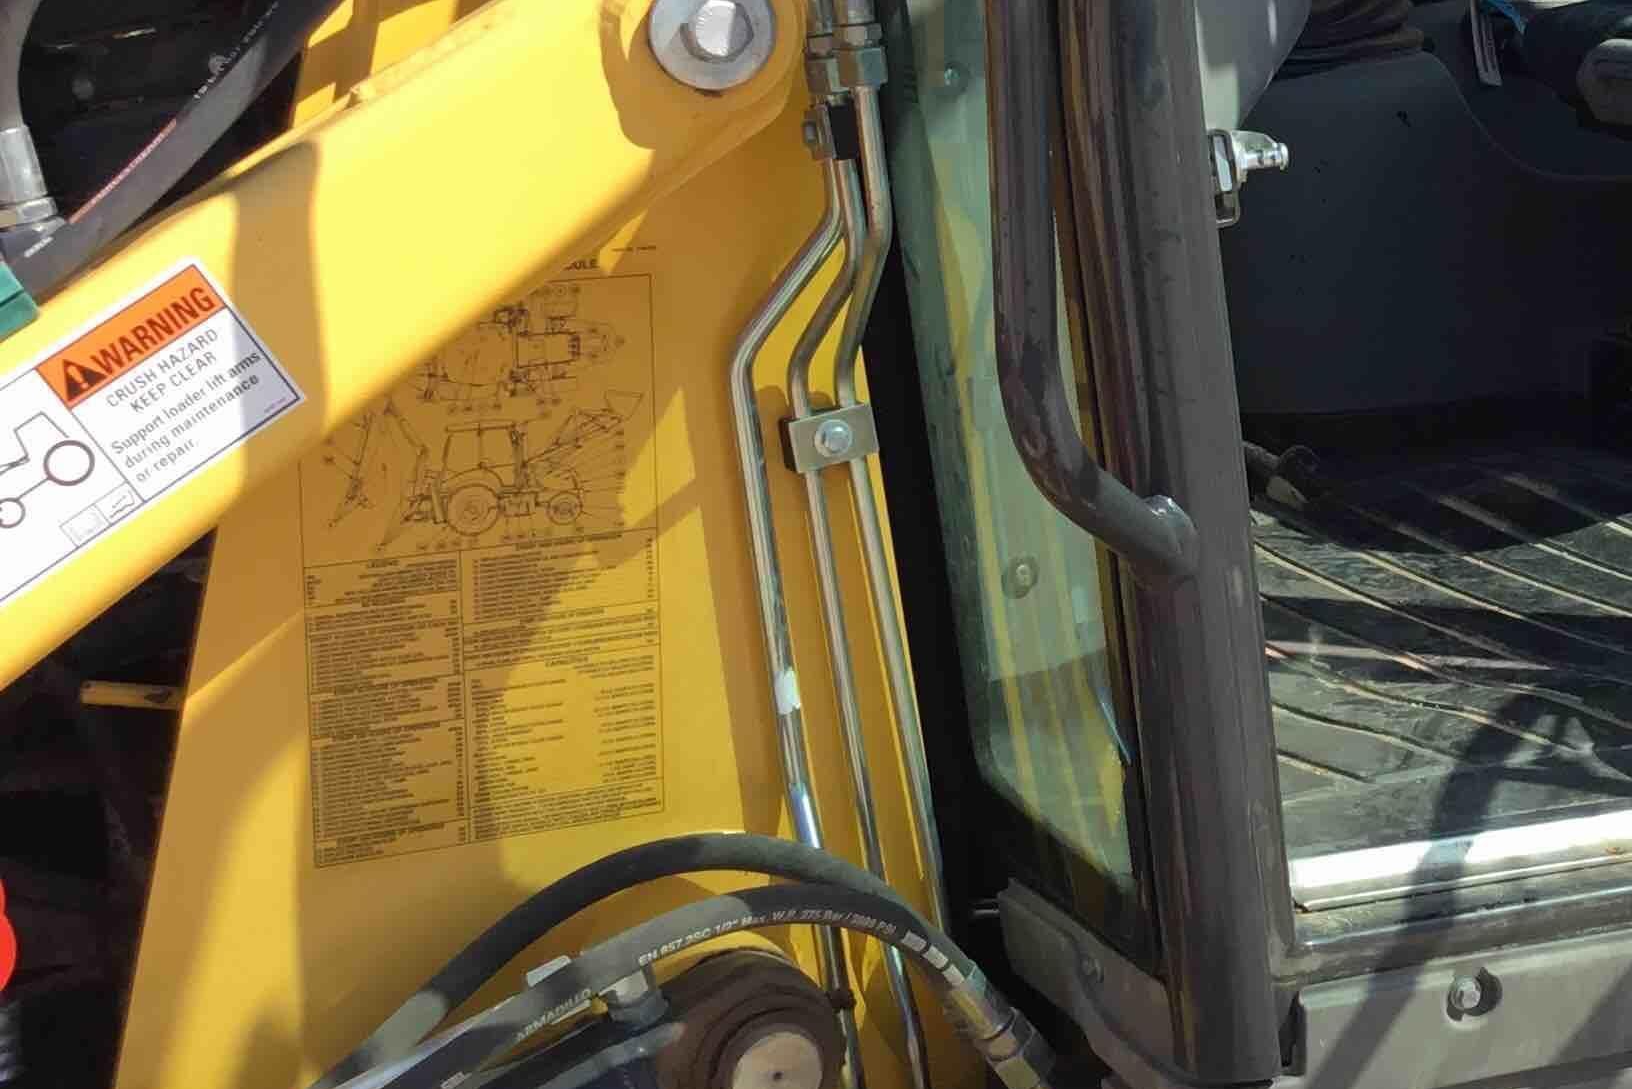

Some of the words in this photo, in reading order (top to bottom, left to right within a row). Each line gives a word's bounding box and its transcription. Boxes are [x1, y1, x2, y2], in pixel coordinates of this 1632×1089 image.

[91, 287, 216, 375] WARNING
[106, 369, 158, 408] CRUSH
[157, 328, 218, 374] HAZARD
[111, 415, 166, 455] Support
[163, 388, 206, 420] loader
[208, 373, 227, 392] lift
[228, 352, 261, 379] arms
[125, 435, 171, 469] during
[170, 374, 260, 439] maintenance
[130, 382, 167, 413] KEEP
[169, 351, 217, 388] CLEAR
[136, 468, 153, 483] or
